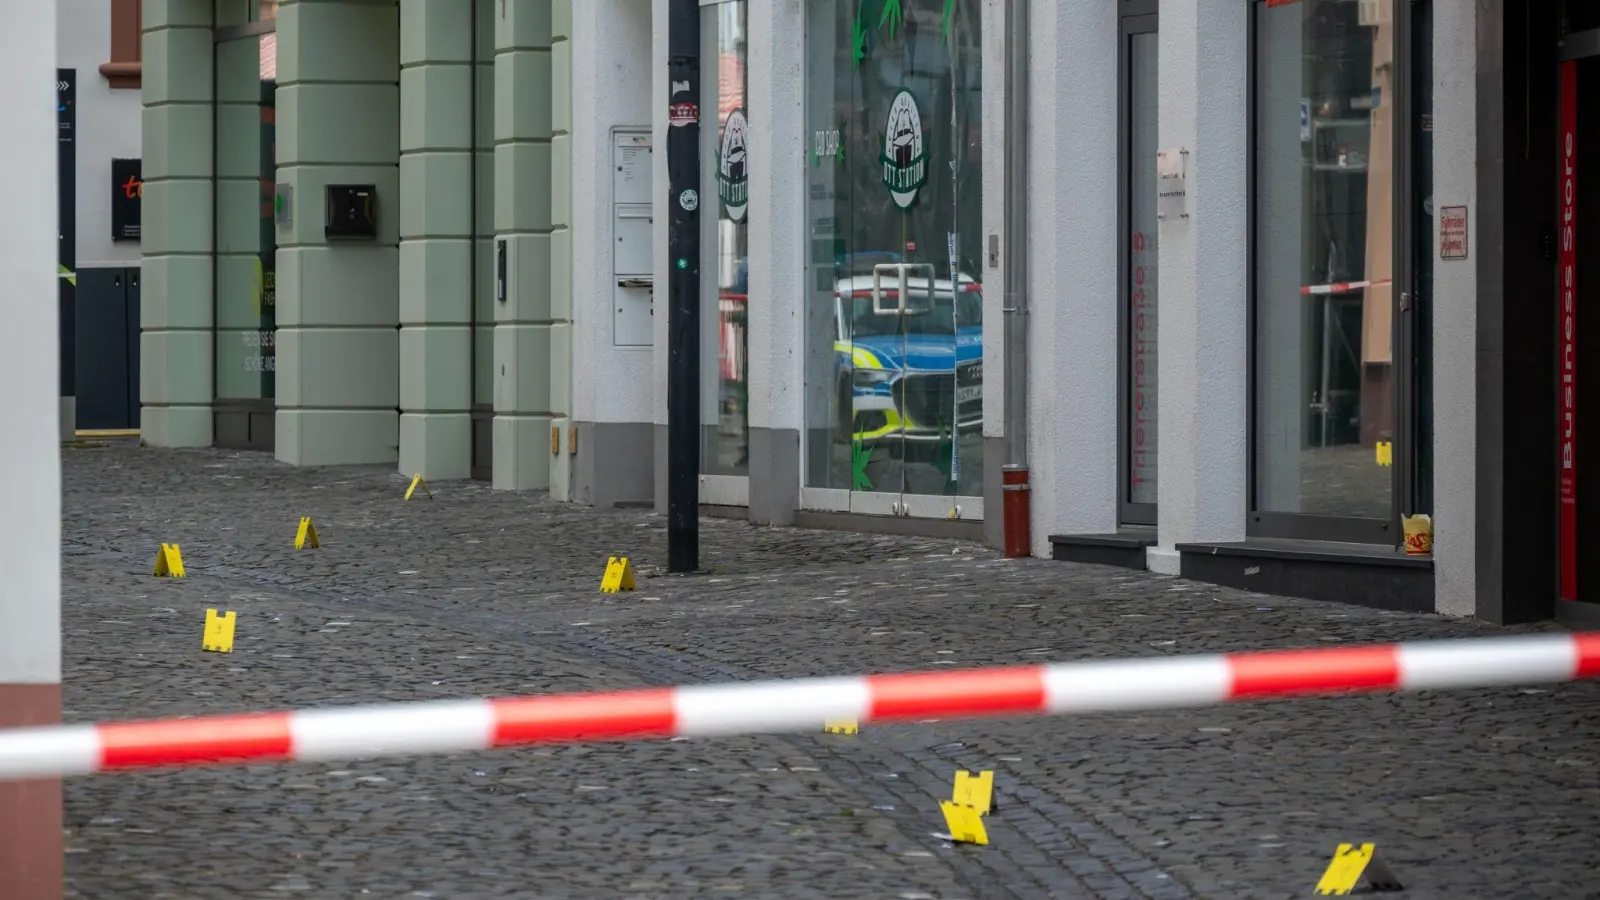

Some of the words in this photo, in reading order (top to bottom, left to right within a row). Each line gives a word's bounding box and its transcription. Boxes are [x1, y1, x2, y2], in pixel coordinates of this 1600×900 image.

[1132, 231, 1145, 252] 5
[1563, 132, 1574, 250] Store
[1132, 265, 1146, 485] Triererstraße
[1563, 264, 1573, 469] Business
